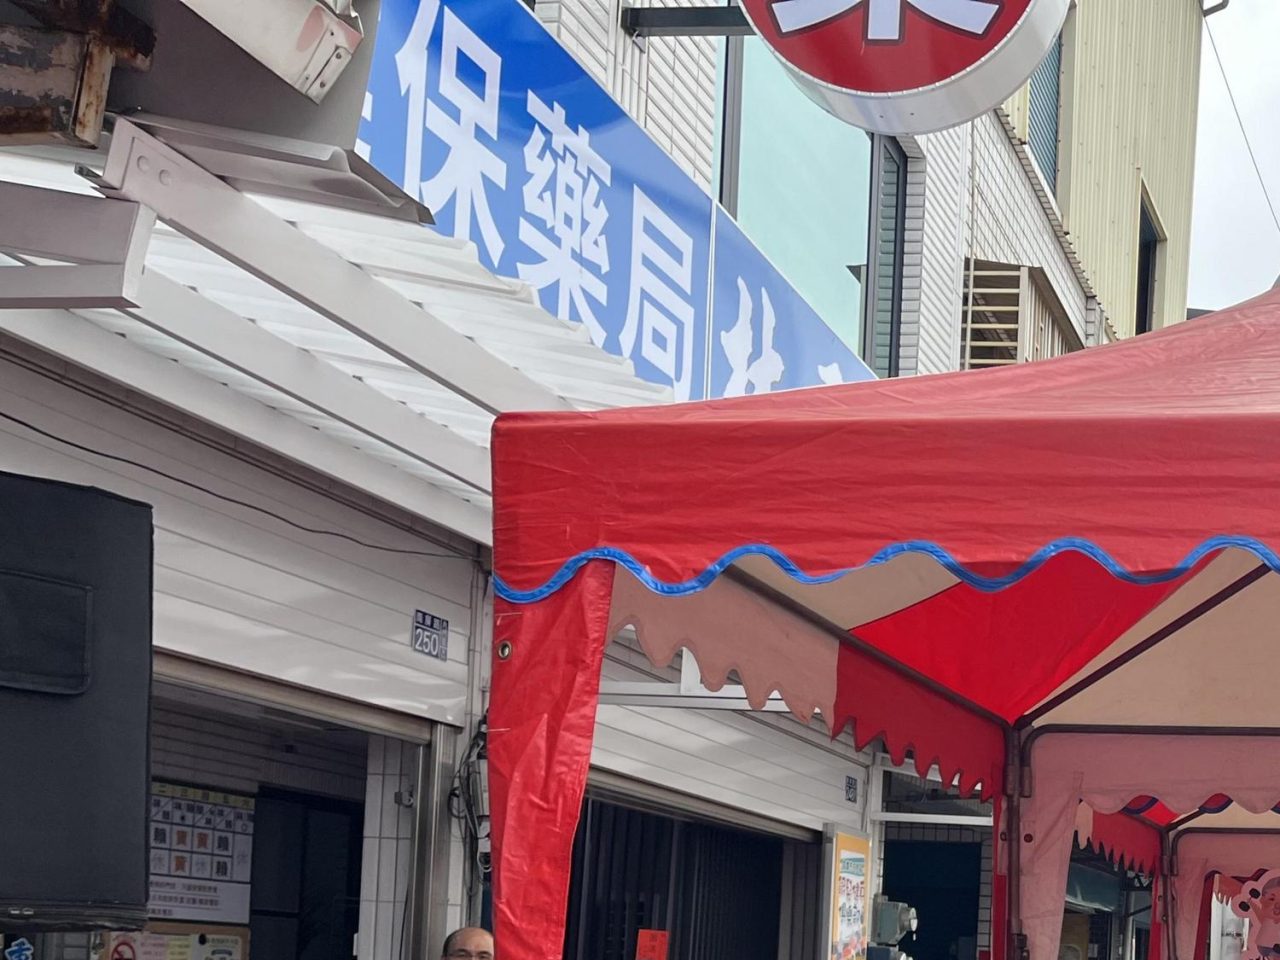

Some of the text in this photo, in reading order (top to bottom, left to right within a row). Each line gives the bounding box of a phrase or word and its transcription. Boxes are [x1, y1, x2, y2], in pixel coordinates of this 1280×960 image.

[356, 0, 694, 400] 保藥局
[415, 628, 439, 656] 250
